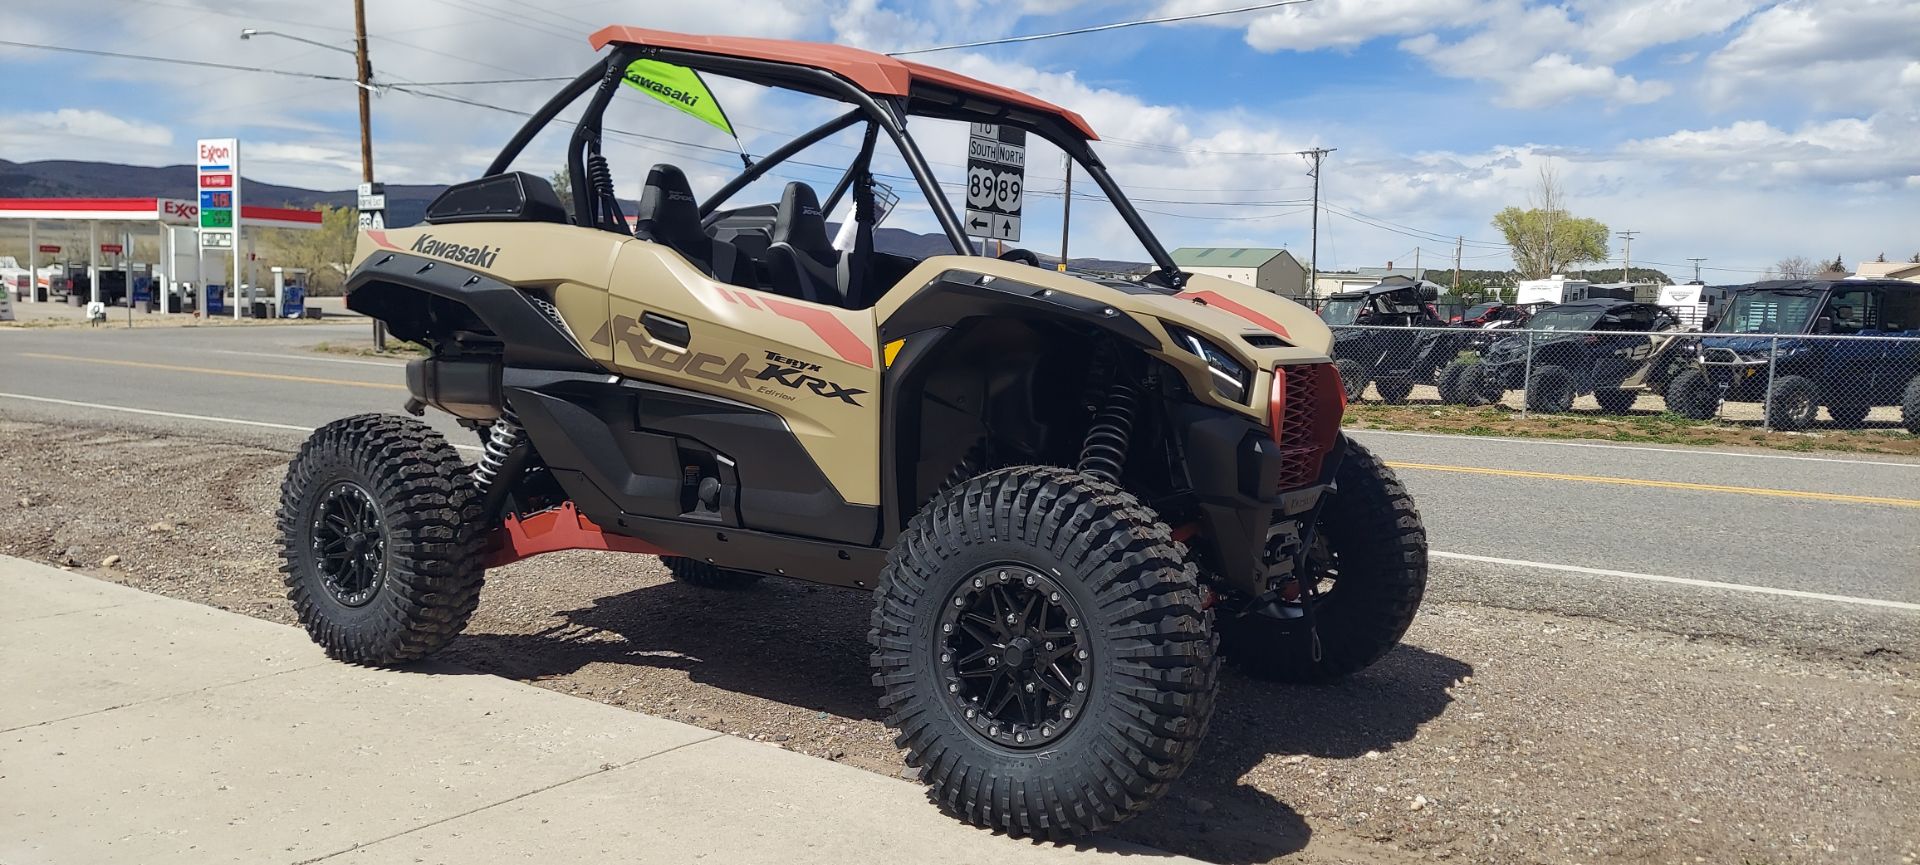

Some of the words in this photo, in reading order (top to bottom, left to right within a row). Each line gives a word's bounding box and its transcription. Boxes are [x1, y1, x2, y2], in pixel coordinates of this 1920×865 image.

[201, 145, 229, 163] Exxon
[970, 140, 996, 159] SOUTH
[999, 146, 1024, 164] NORTH
[970, 174, 993, 198] 89
[998, 180, 1020, 203] 89
[164, 201, 198, 219] Exxo
[410, 233, 501, 269] Kawasaki
[755, 362, 870, 408] KRX
